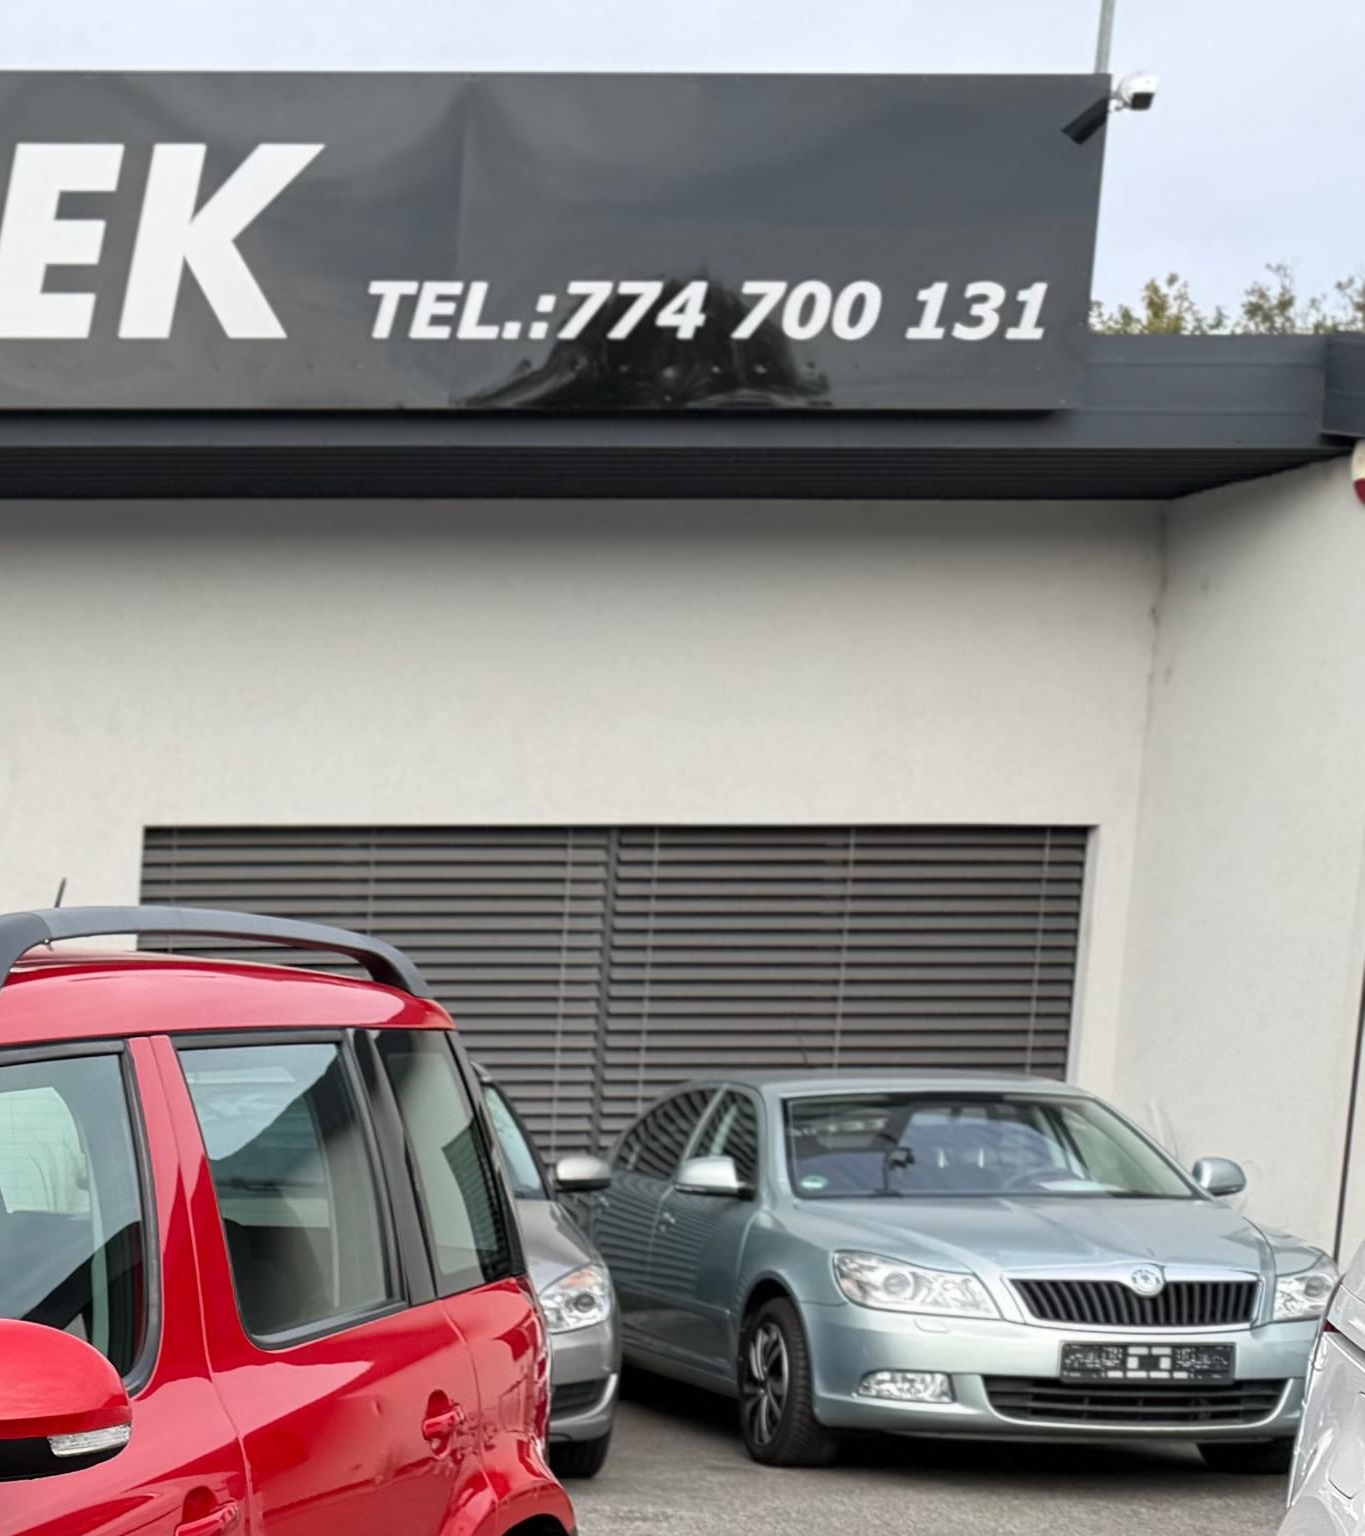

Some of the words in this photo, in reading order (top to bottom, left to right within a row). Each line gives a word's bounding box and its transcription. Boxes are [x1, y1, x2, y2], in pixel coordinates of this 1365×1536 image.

[367, 281, 706, 340] TEL.:774
[731, 281, 882, 340] 700
[905, 281, 1048, 340] 131
